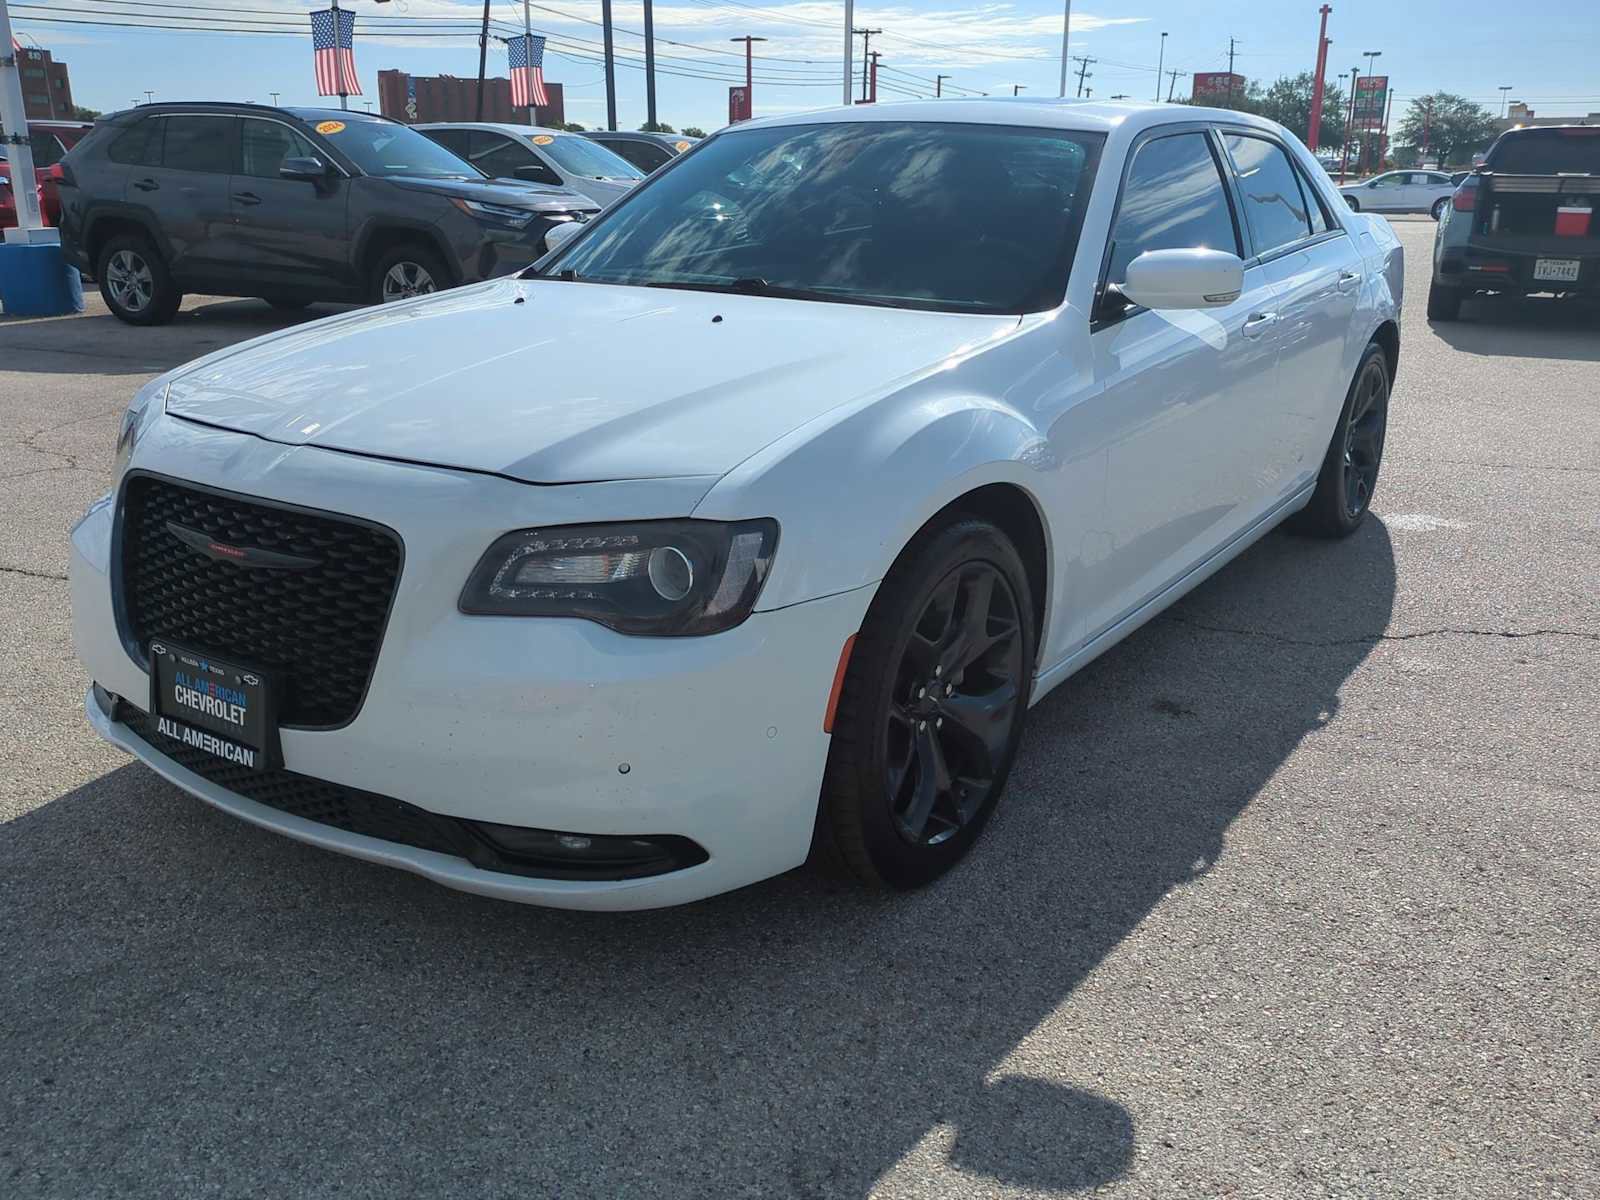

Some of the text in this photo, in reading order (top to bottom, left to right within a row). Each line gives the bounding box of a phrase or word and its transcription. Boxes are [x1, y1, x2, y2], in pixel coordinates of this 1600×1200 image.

[175, 671, 247, 706] ALL AMERICAN
[175, 685, 247, 726] CHEVROLET
[157, 717, 254, 767] ALL AMERICAN
